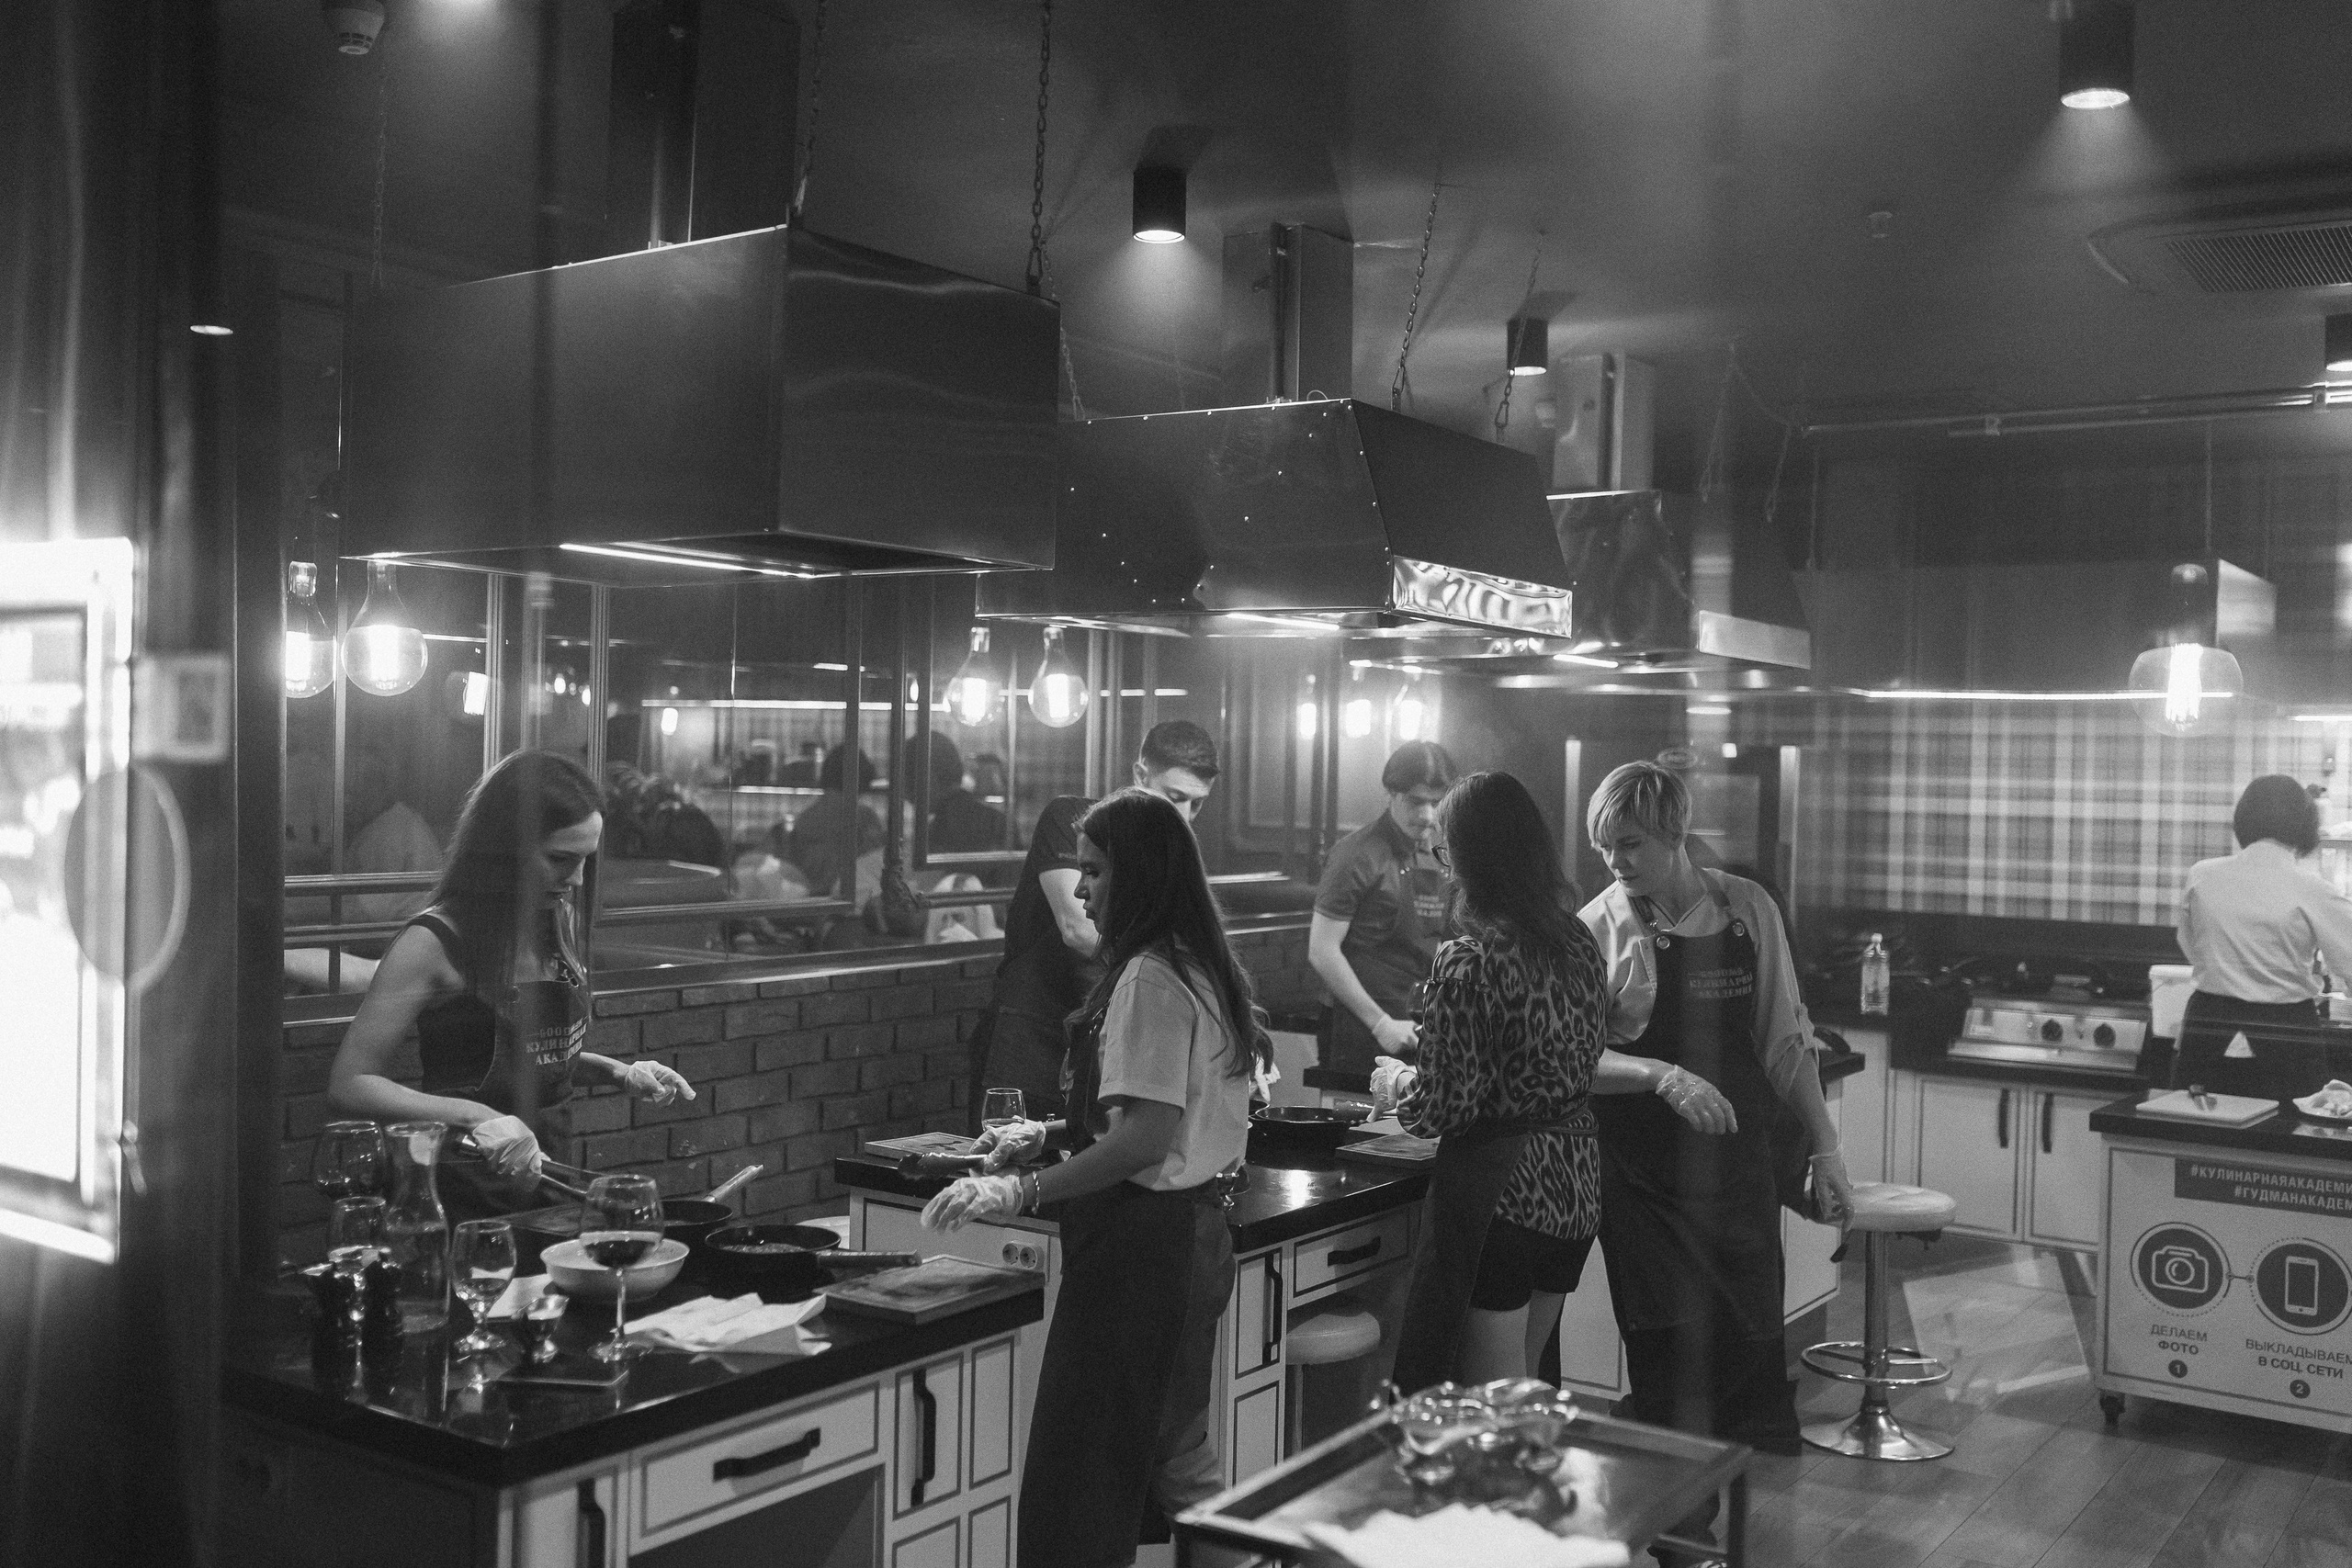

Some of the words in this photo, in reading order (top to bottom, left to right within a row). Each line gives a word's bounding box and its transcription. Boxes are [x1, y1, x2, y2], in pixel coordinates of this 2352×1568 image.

[2151, 1325, 2207, 1342] ДЕЛАЕМ
[2158, 1340, 2199, 1355] ФОТО
[2258, 1356, 2267, 1366] В
[2307, 1363, 2344, 1379] СЕТИ
[2296, 1383, 2304, 1394] 2
